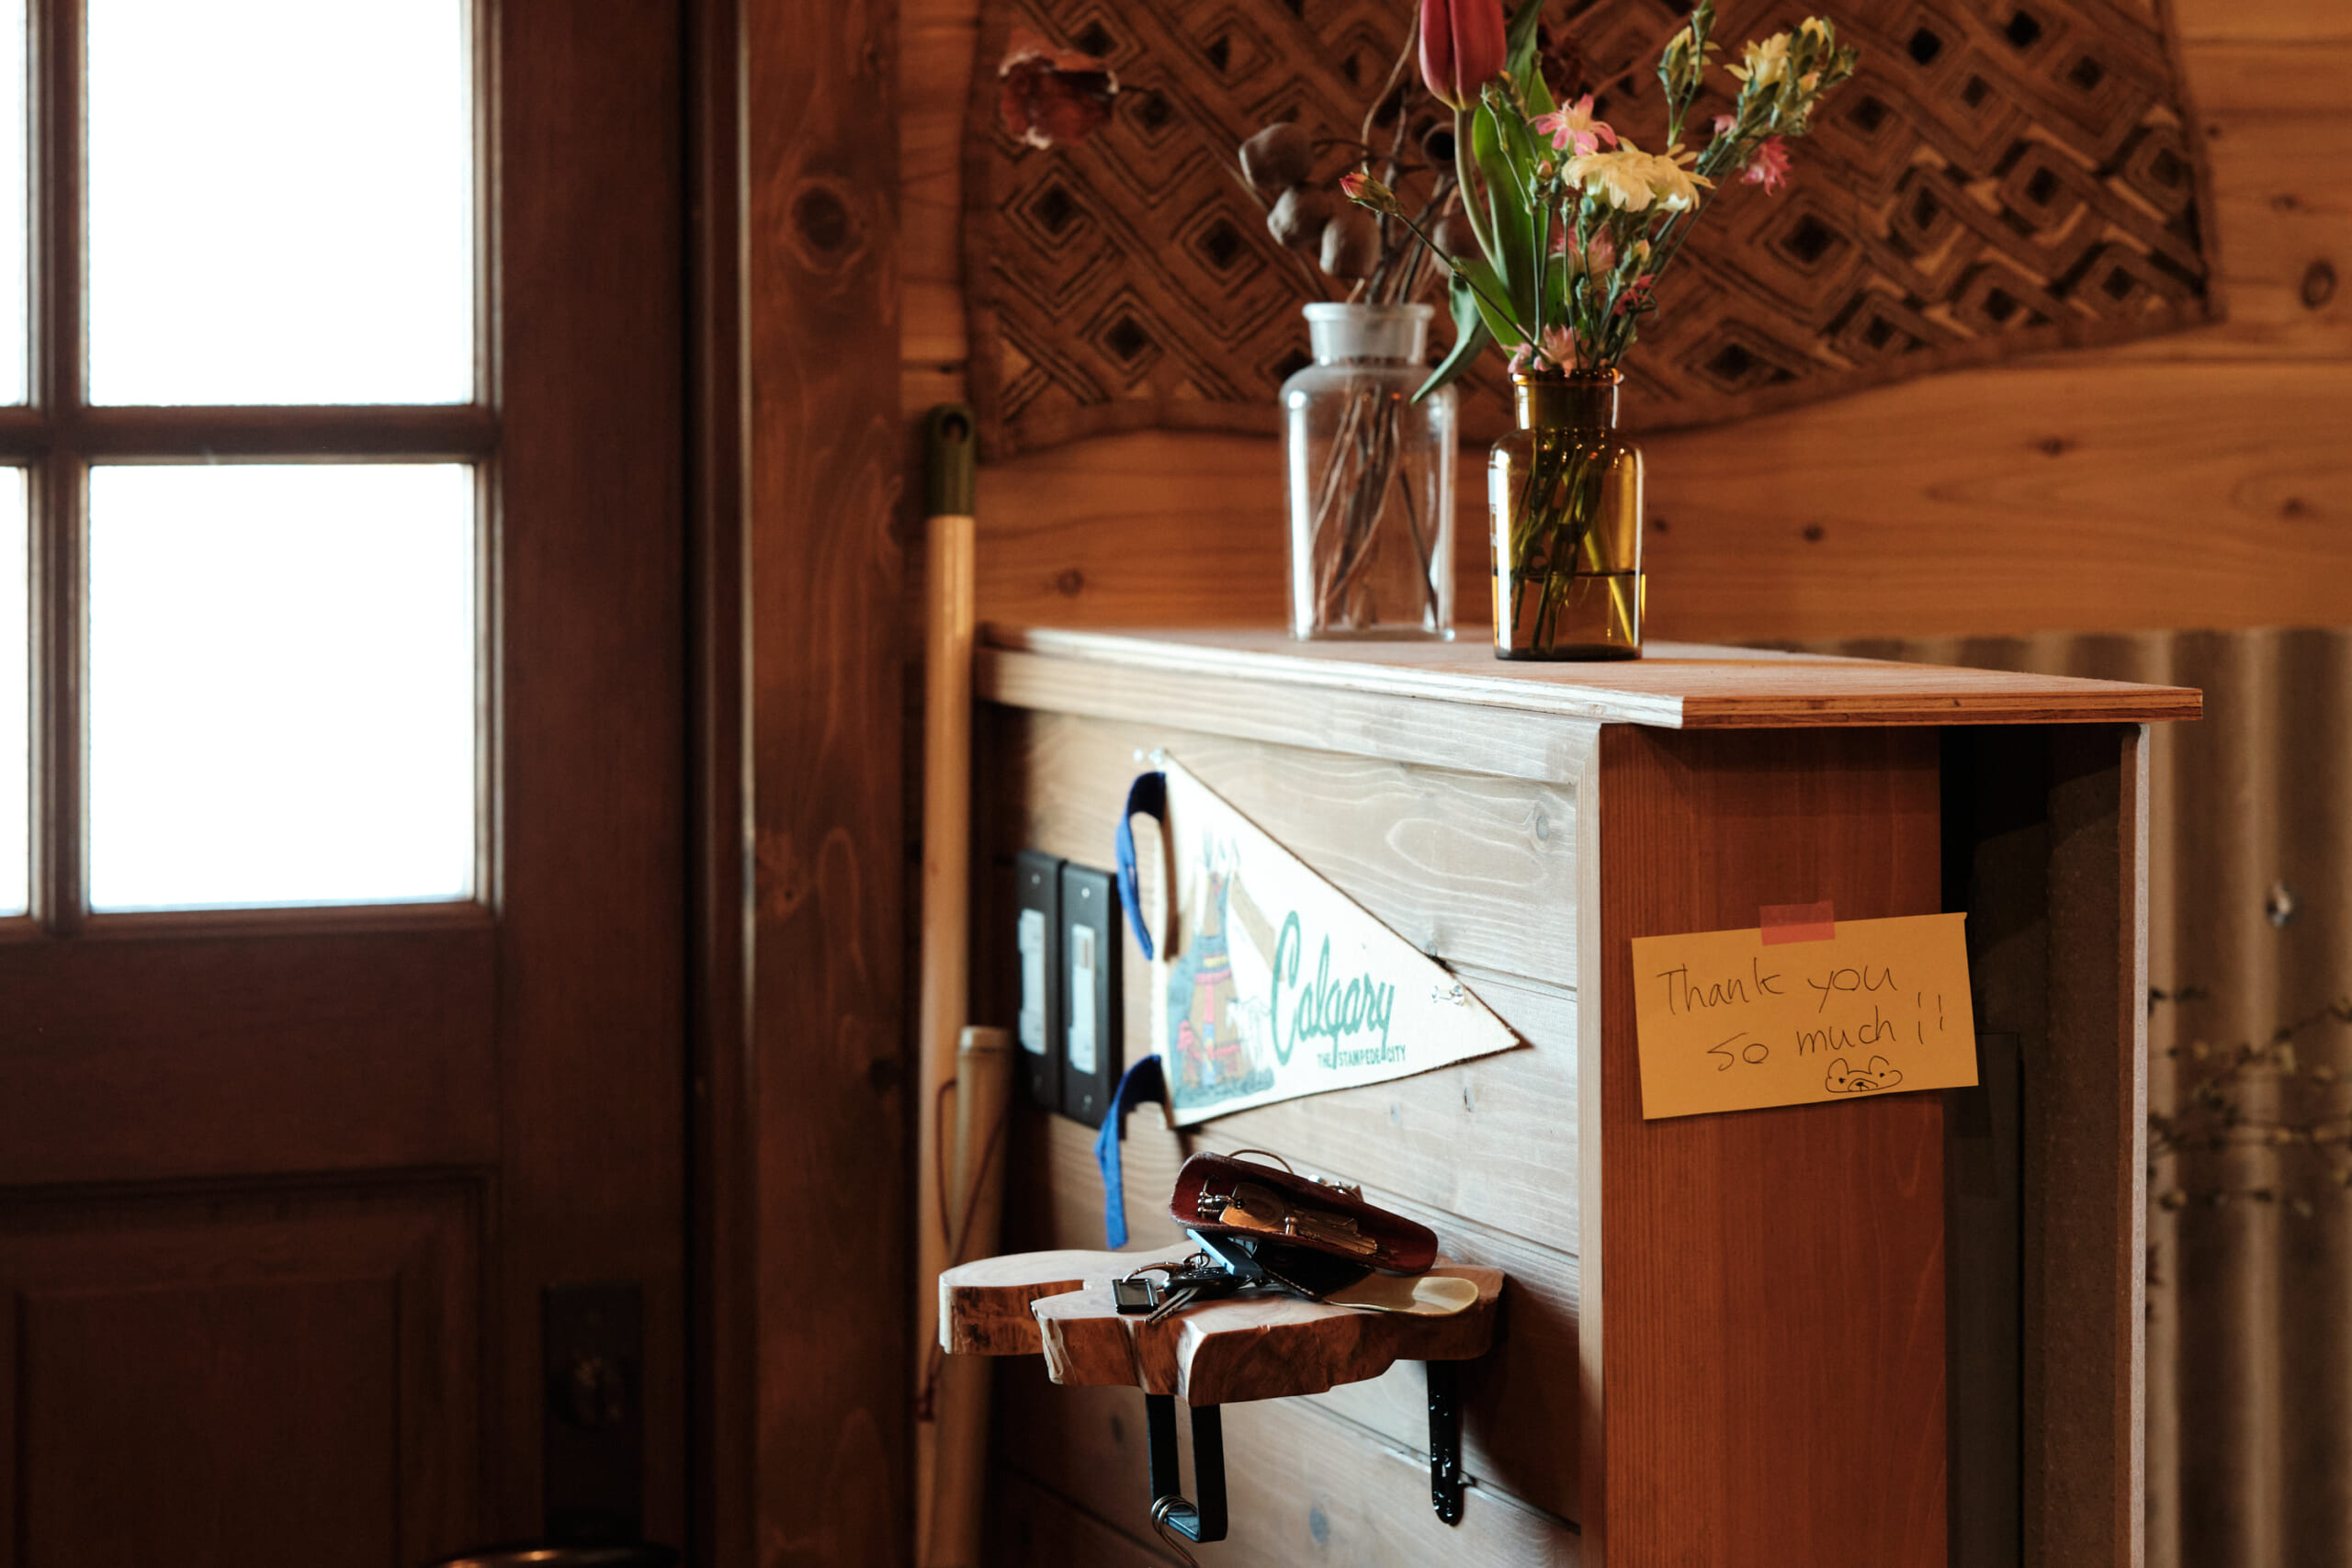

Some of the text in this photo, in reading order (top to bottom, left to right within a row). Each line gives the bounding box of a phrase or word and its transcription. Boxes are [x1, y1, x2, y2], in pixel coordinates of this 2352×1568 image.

[1272, 910, 1395, 1069] Calgary
[1657, 956, 1898, 1014] Thank you
[1317, 1044, 1407, 1068] THE STAMPEDE CITY
